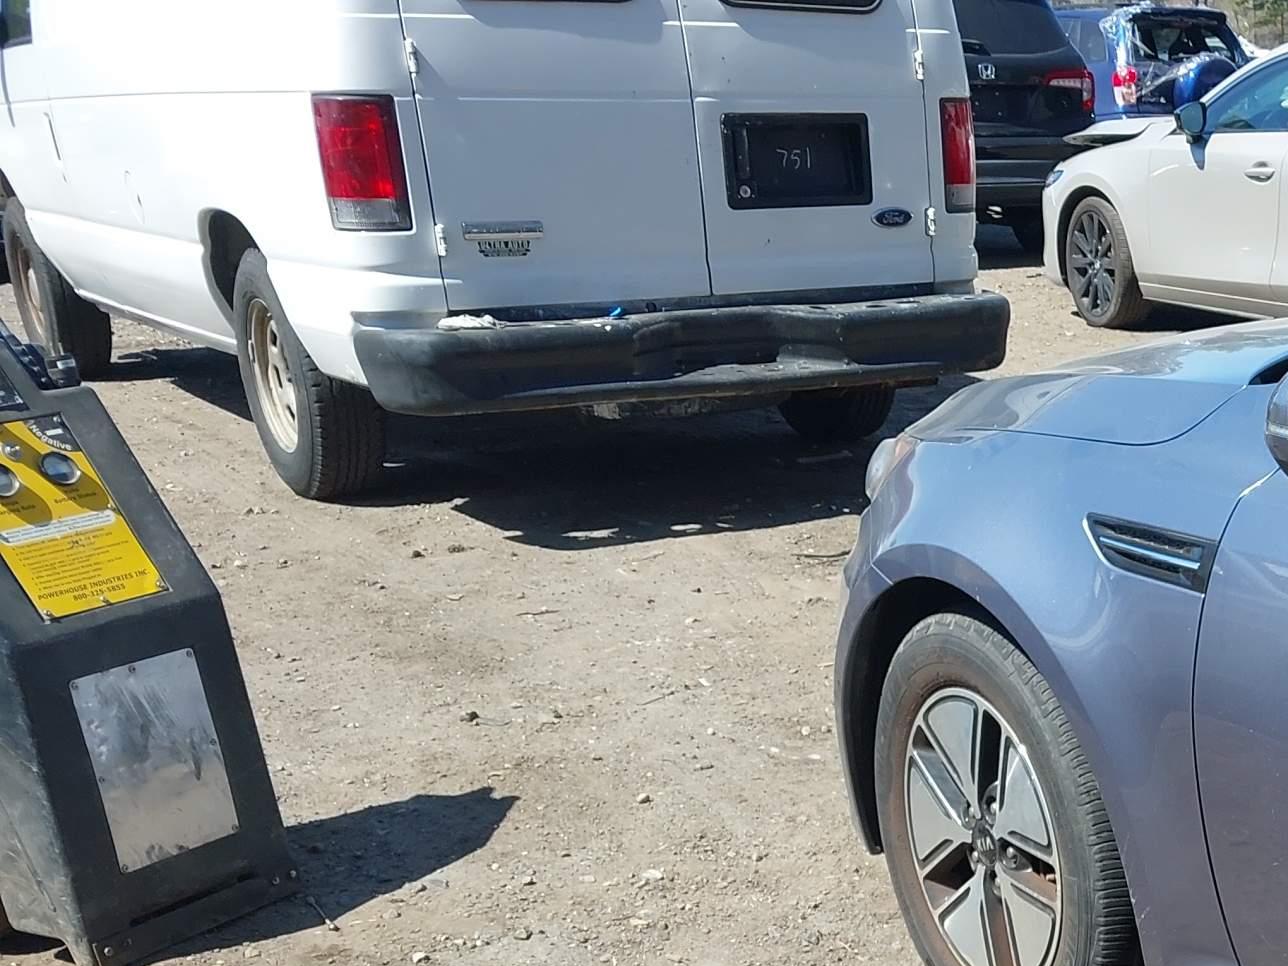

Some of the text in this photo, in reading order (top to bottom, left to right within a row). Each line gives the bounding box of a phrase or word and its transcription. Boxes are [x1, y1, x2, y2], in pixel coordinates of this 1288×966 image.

[776, 147, 811, 169] 751
[30, 424, 72, 451] Negative
[38, 583, 88, 601] POWERHOUSE
[89, 571, 135, 591] INDUSTRIES
